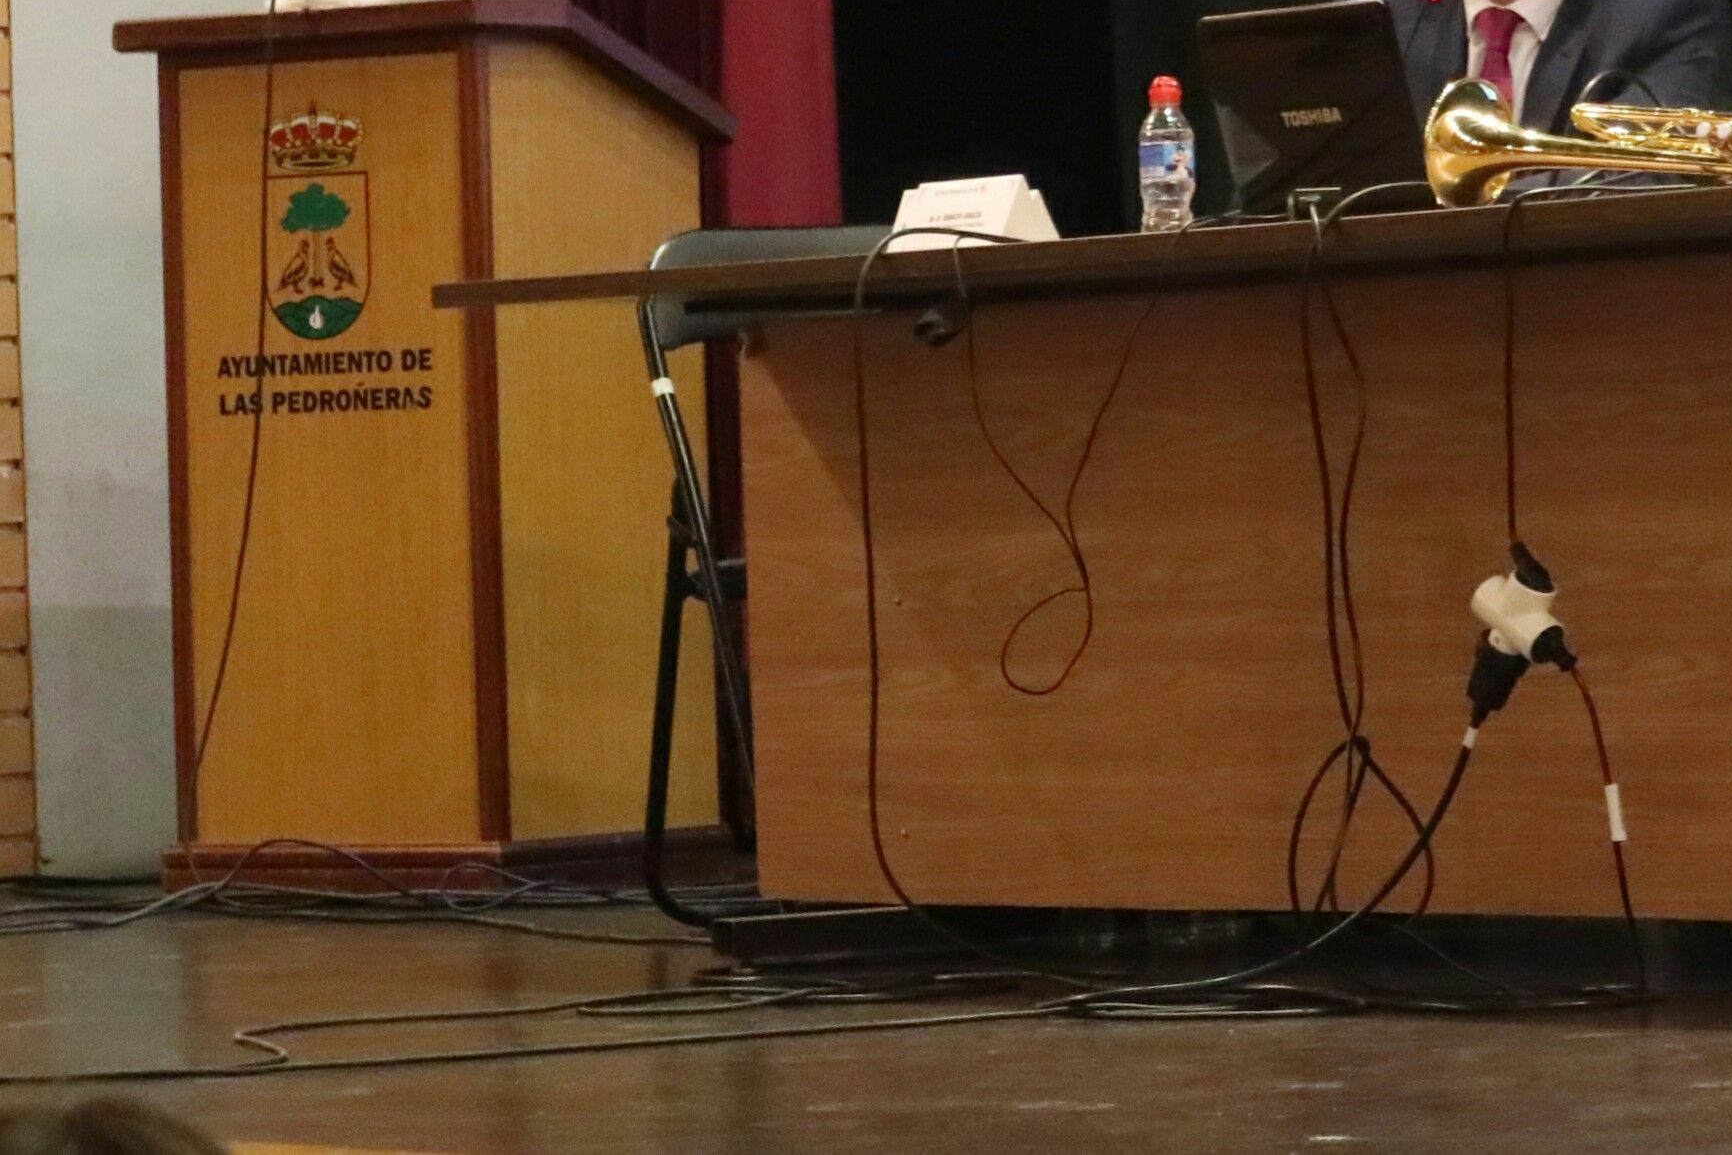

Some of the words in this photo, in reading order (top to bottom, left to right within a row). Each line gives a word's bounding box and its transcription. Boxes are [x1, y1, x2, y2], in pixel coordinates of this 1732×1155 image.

[1280, 107, 1343, 128] TOSHIBA
[217, 349, 394, 378] AYUNTAMIENTO
[401, 348, 433, 372] DE
[219, 393, 264, 416] LAS
[271, 381, 433, 415] PEDROÑERAS
